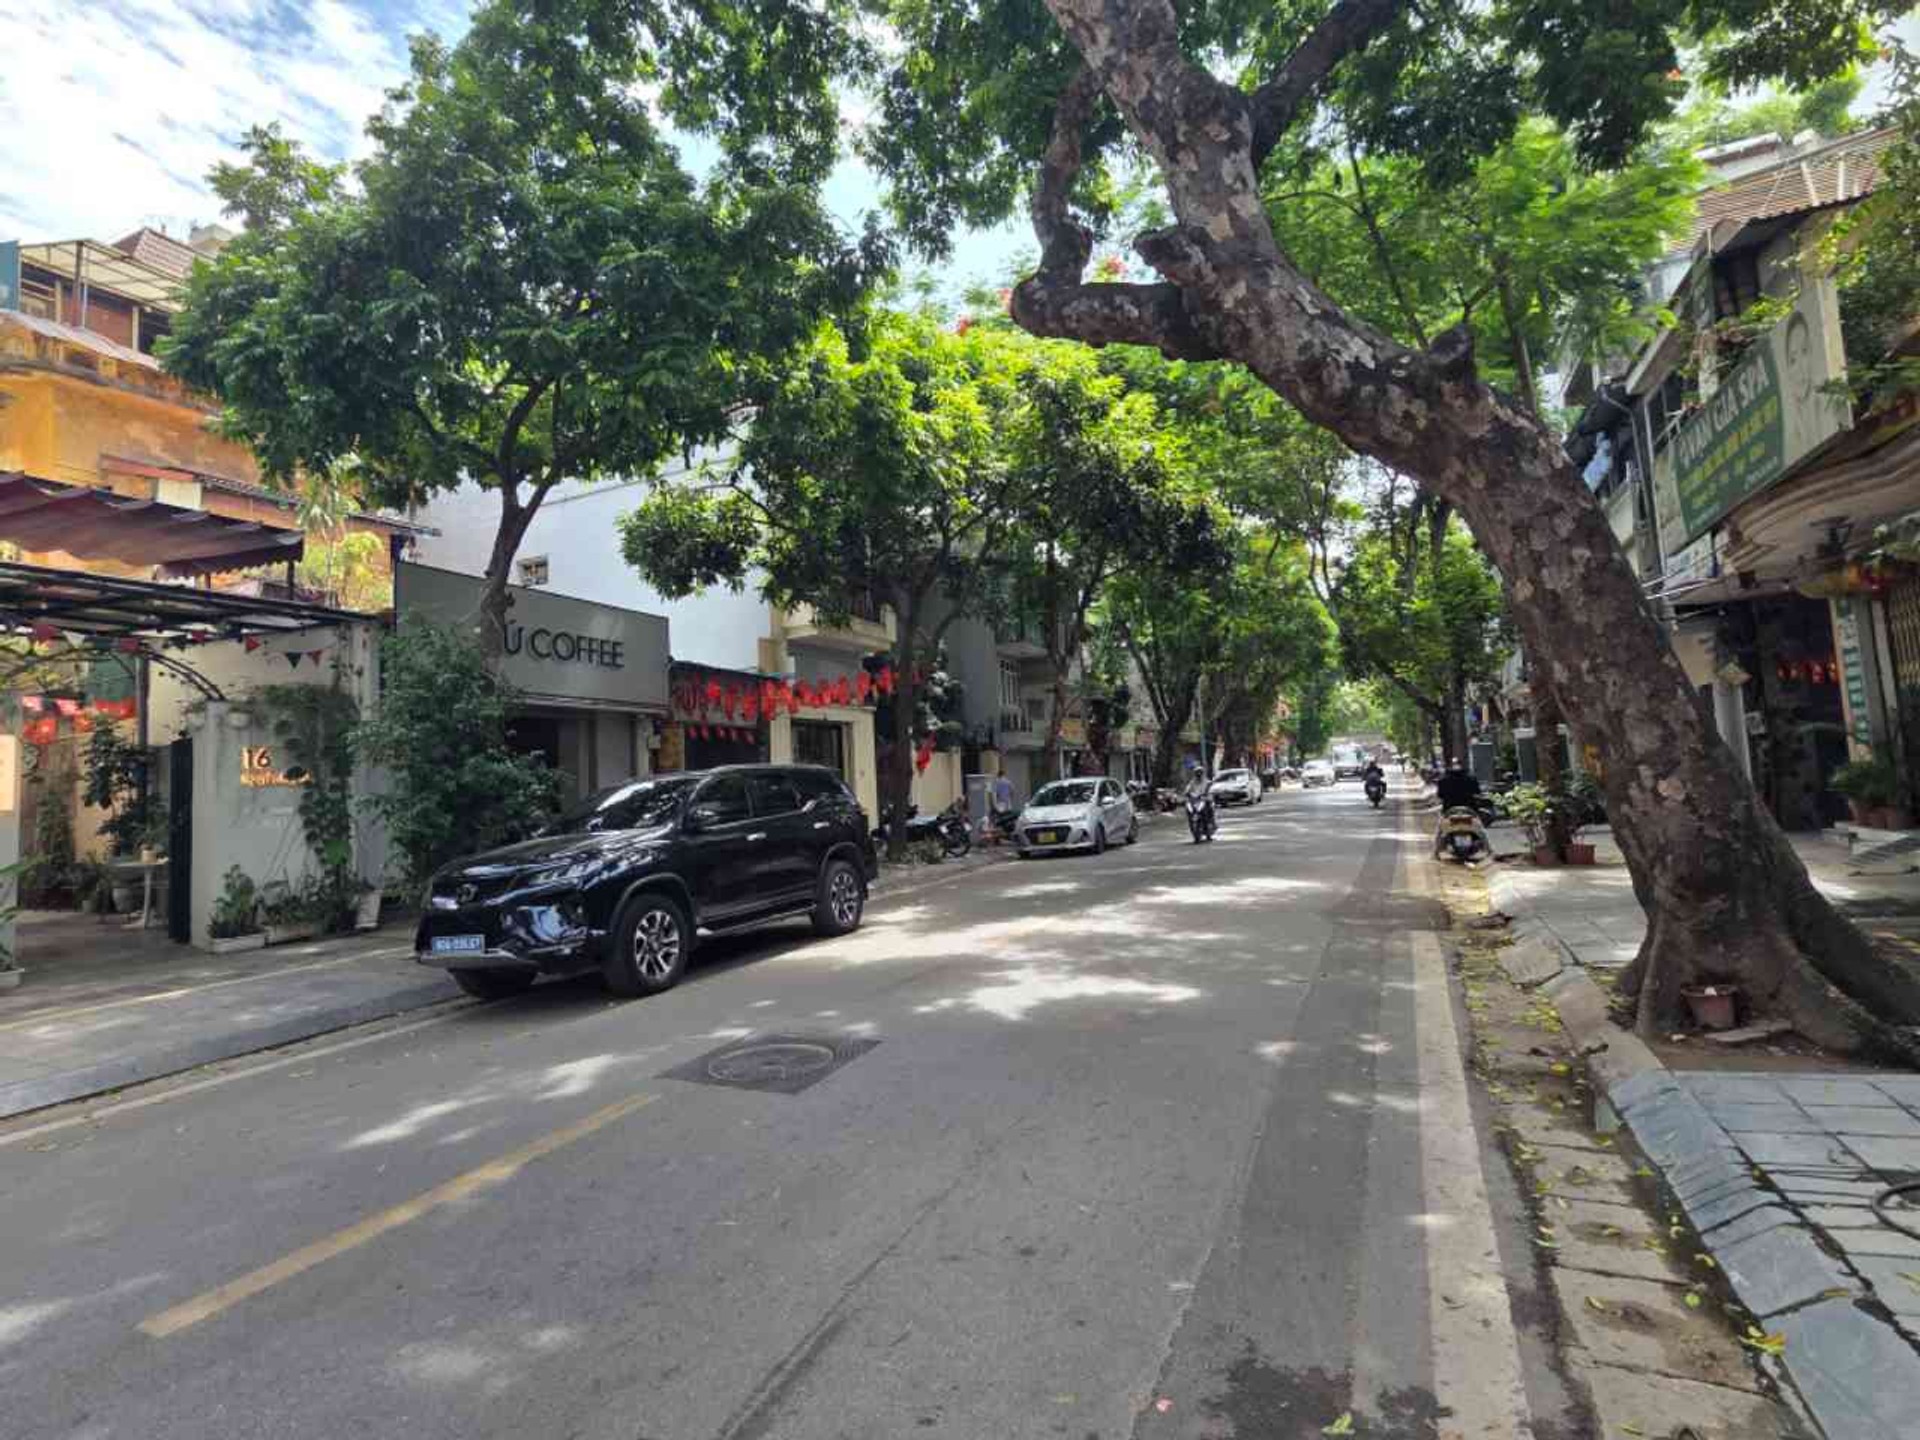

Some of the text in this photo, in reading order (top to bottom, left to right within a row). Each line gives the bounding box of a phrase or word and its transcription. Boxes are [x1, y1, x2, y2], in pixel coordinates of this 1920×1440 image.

[1738, 356, 1770, 409] SPA
[530, 628, 625, 668] COFFEE
[245, 748, 271, 768] 16
